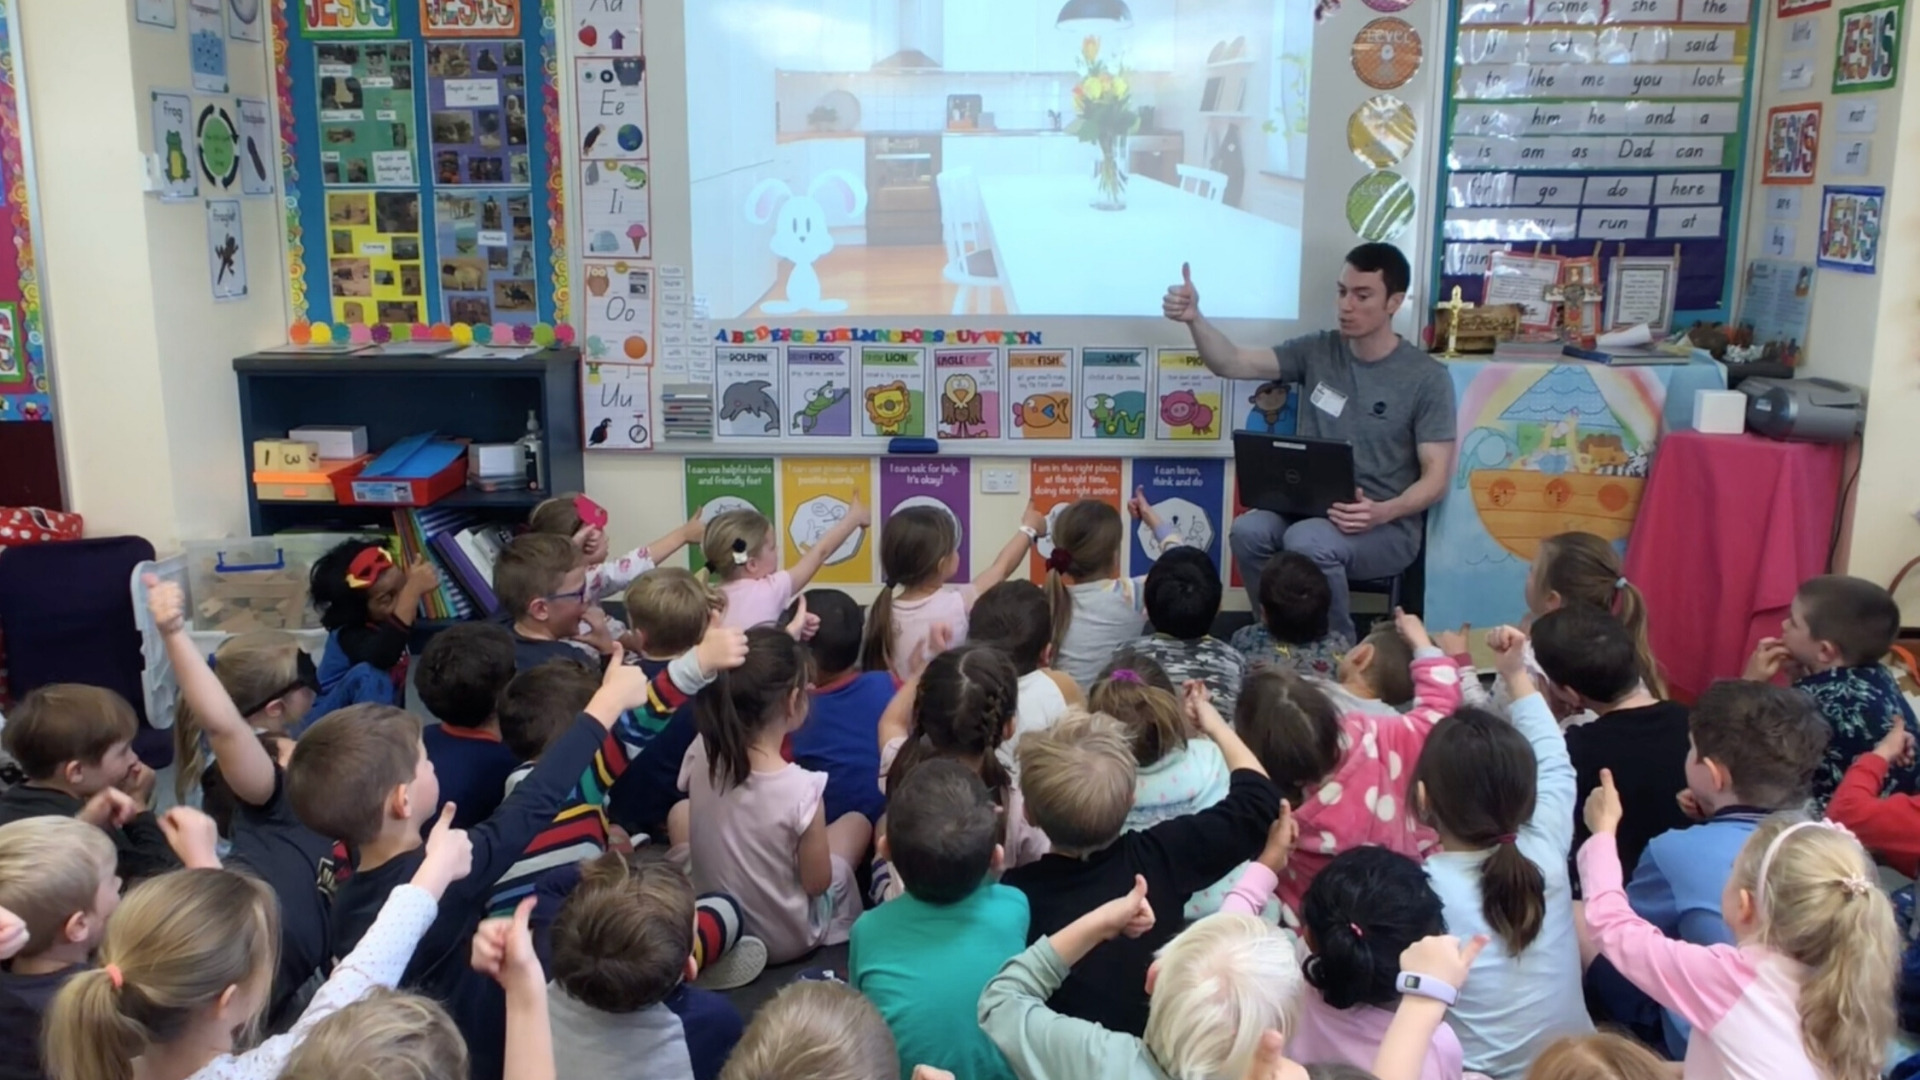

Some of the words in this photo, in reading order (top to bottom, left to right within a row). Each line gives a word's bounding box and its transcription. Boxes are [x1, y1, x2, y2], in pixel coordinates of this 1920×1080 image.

[1547, 0, 1589, 13] come
[1630, 0, 1658, 12] she
[1702, 0, 1727, 13] the
[1684, 36, 1718, 53] said
[1485, 71, 1502, 87] to
[1525, 67, 1555, 87] like
[1581, 74, 1604, 87] me
[1634, 74, 1662, 95] you
[1692, 66, 1725, 87] look
[600, 89, 625, 116] Ee
[163, 100, 183, 124] frog
[1532, 106, 1562, 125] him
[1588, 110, 1606, 125] he
[1644, 107, 1675, 125] and
[1699, 113, 1709, 125] a
[1478, 144, 1491, 158] is
[1521, 147, 1545, 159] am
[1571, 147, 1588, 159] as
[1617, 139, 1654, 159] Dad
[1675, 146, 1703, 159] can
[1537, 185, 1559, 205] go
[1607, 178, 1627, 197] do
[1669, 177, 1704, 197] here
[609, 187, 624, 214] Ii
[1597, 217, 1628, 231] run
[1682, 213, 1697, 230] at
[606, 295, 635, 322] Oo
[729, 352, 768, 363] DOLPHIN
[808, 352, 835, 363] FROG
[885, 352, 908, 363] LION
[937, 354, 964, 367] EAGLE
[1037, 355, 1060, 366] FISH
[601, 382, 633, 408] Uu
[722, 463, 747, 477] helpful
[748, 463, 772, 475] hands
[894, 466, 910, 474] can
[911, 463, 928, 474] ask
[928, 463, 940, 474] for
[941, 463, 960, 476] help.
[1037, 466, 1051, 474] am
[1051, 464, 1061, 474] in
[1061, 464, 1075, 474] the
[1075, 464, 1094, 477] right
[1159, 467, 1175, 475] can
[1176, 465, 1202, 477] listen,
[698, 475, 714, 486] and
[714, 475, 745, 488] friendly
[906, 475, 920, 485] It's
[920, 475, 944, 487] okay!
[1044, 475, 1054, 484] at
[1055, 475, 1068, 484] the
[1069, 475, 1087, 487] right
[1153, 476, 1174, 487] think
[1175, 477, 1191, 486] and
[1192, 476, 1204, 486] do
[1034, 486, 1057, 498] doing
[1058, 486, 1072, 496] the
[1072, 486, 1091, 498] right
[1092, 486, 1118, 496] action
